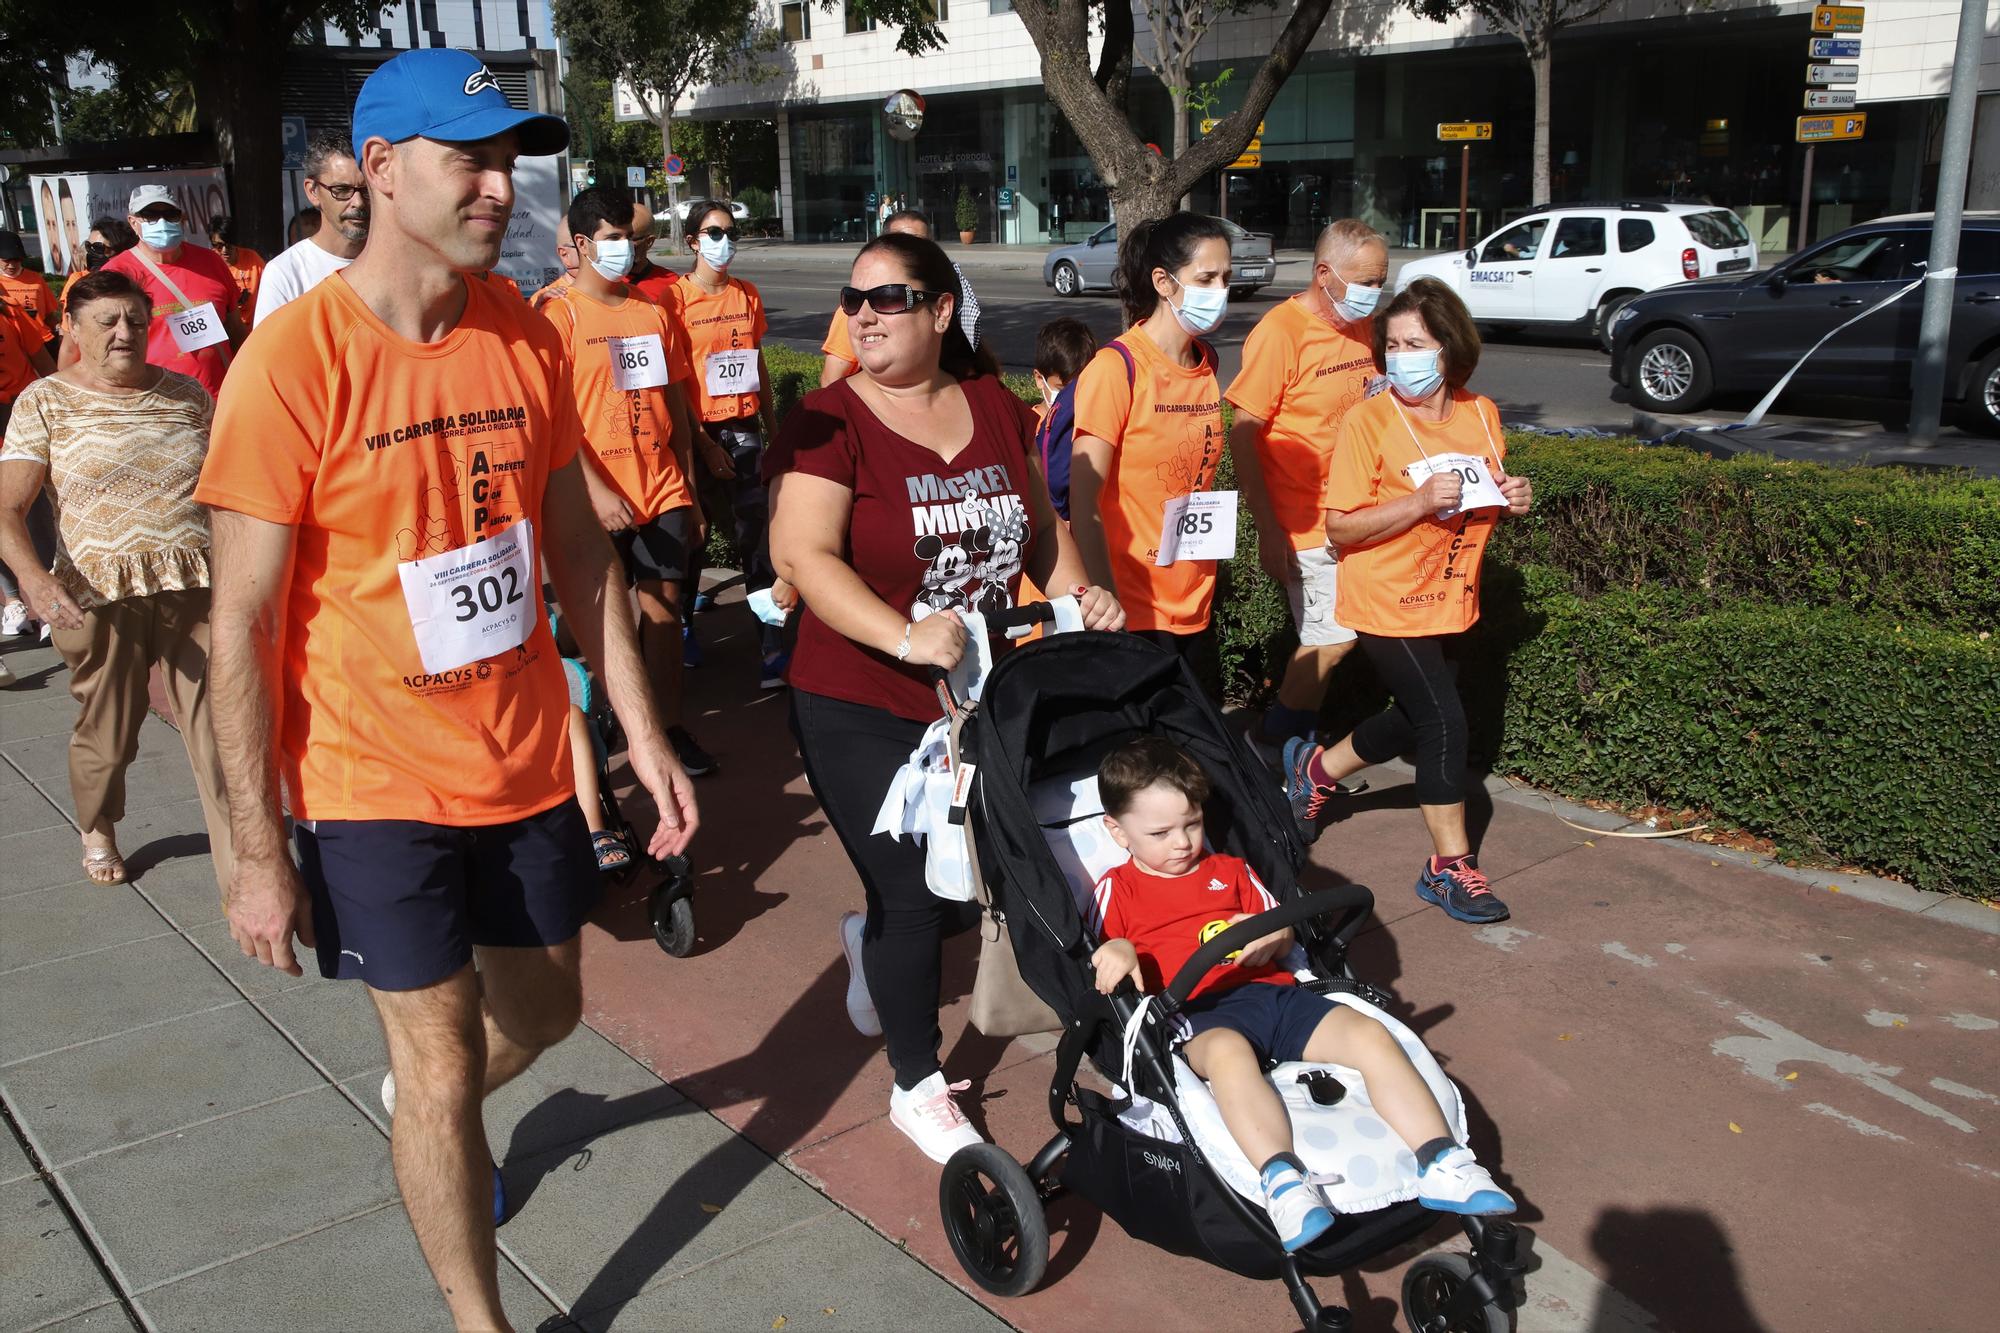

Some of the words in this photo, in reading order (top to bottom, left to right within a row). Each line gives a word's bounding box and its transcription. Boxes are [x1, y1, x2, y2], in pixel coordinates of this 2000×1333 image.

[282, 122, 298, 145] P
[919, 154, 942, 163] HOTEL
[511, 211, 531, 219] acer
[507, 224, 544, 239] lidad...
[1471, 271, 1504, 282] EMACSA
[180, 318, 207, 336] 088
[619, 350, 649, 370] 086
[718, 363, 745, 379] 207
[1315, 369, 1327, 377] VIII
[1327, 362, 1354, 374] CARRERA
[1154, 404, 1166, 413] VIII
[1166, 404, 1195, 413] CARRERA
[365, 432, 392, 451] VIII
[393, 415, 456, 443] CARRERA
[459, 406, 526, 427] SOLIDARIA
[467, 424, 487, 435] ANDA
[487, 423, 493, 432] O
[493, 422, 514, 432] RUEDA
[601, 447, 632, 456] ACPACYS
[905, 464, 1012, 503] MICKEY
[961, 488, 986, 514] &
[1176, 512, 1213, 537] 085
[434, 569, 449, 580] VIII
[449, 559, 487, 575] CARRERA
[488, 543, 517, 566] SOLIDARIA
[451, 566, 523, 622] 302
[1400, 594, 1435, 604] ACPACYS
[482, 618, 510, 633] ACPACYS
[403, 668, 472, 689] ACPACYS
